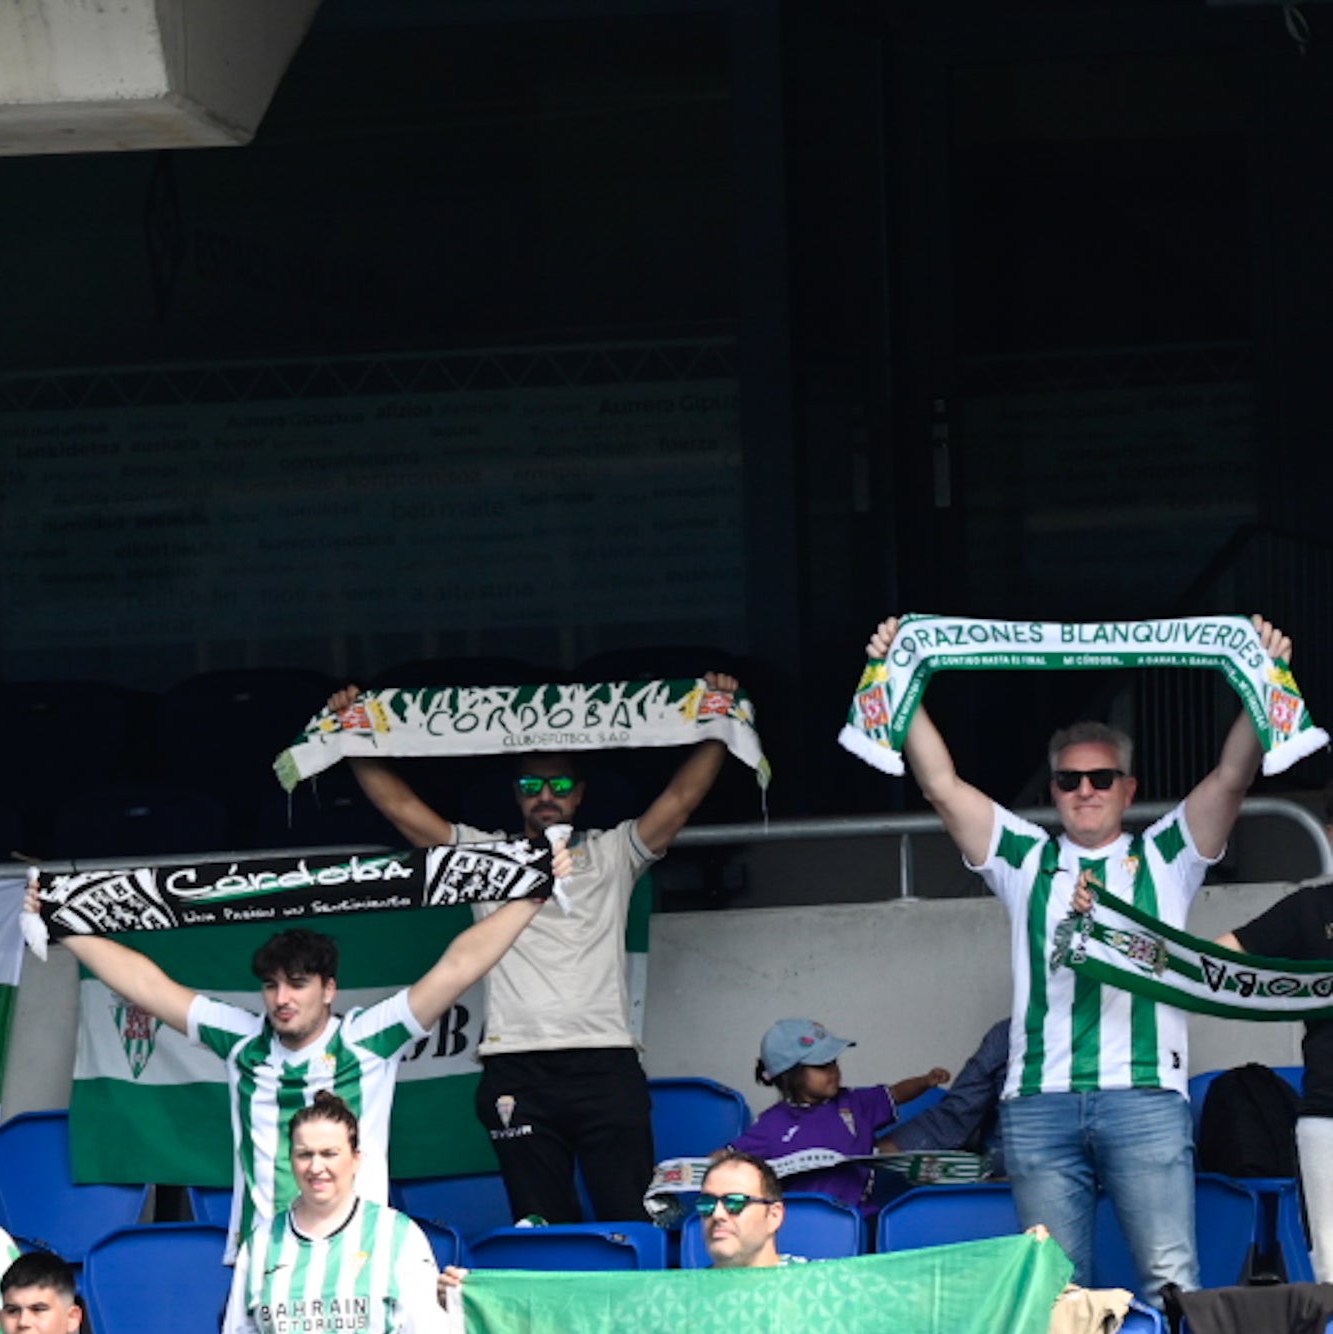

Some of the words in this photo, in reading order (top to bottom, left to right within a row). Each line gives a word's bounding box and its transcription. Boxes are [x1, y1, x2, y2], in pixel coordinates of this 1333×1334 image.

[892, 622, 1043, 668] CORAZONES
[1061, 622, 1264, 670] BLANQUIVERDES
[166, 855, 413, 898] Córdoba
[261, 1298, 367, 1321] BAHRAIN
